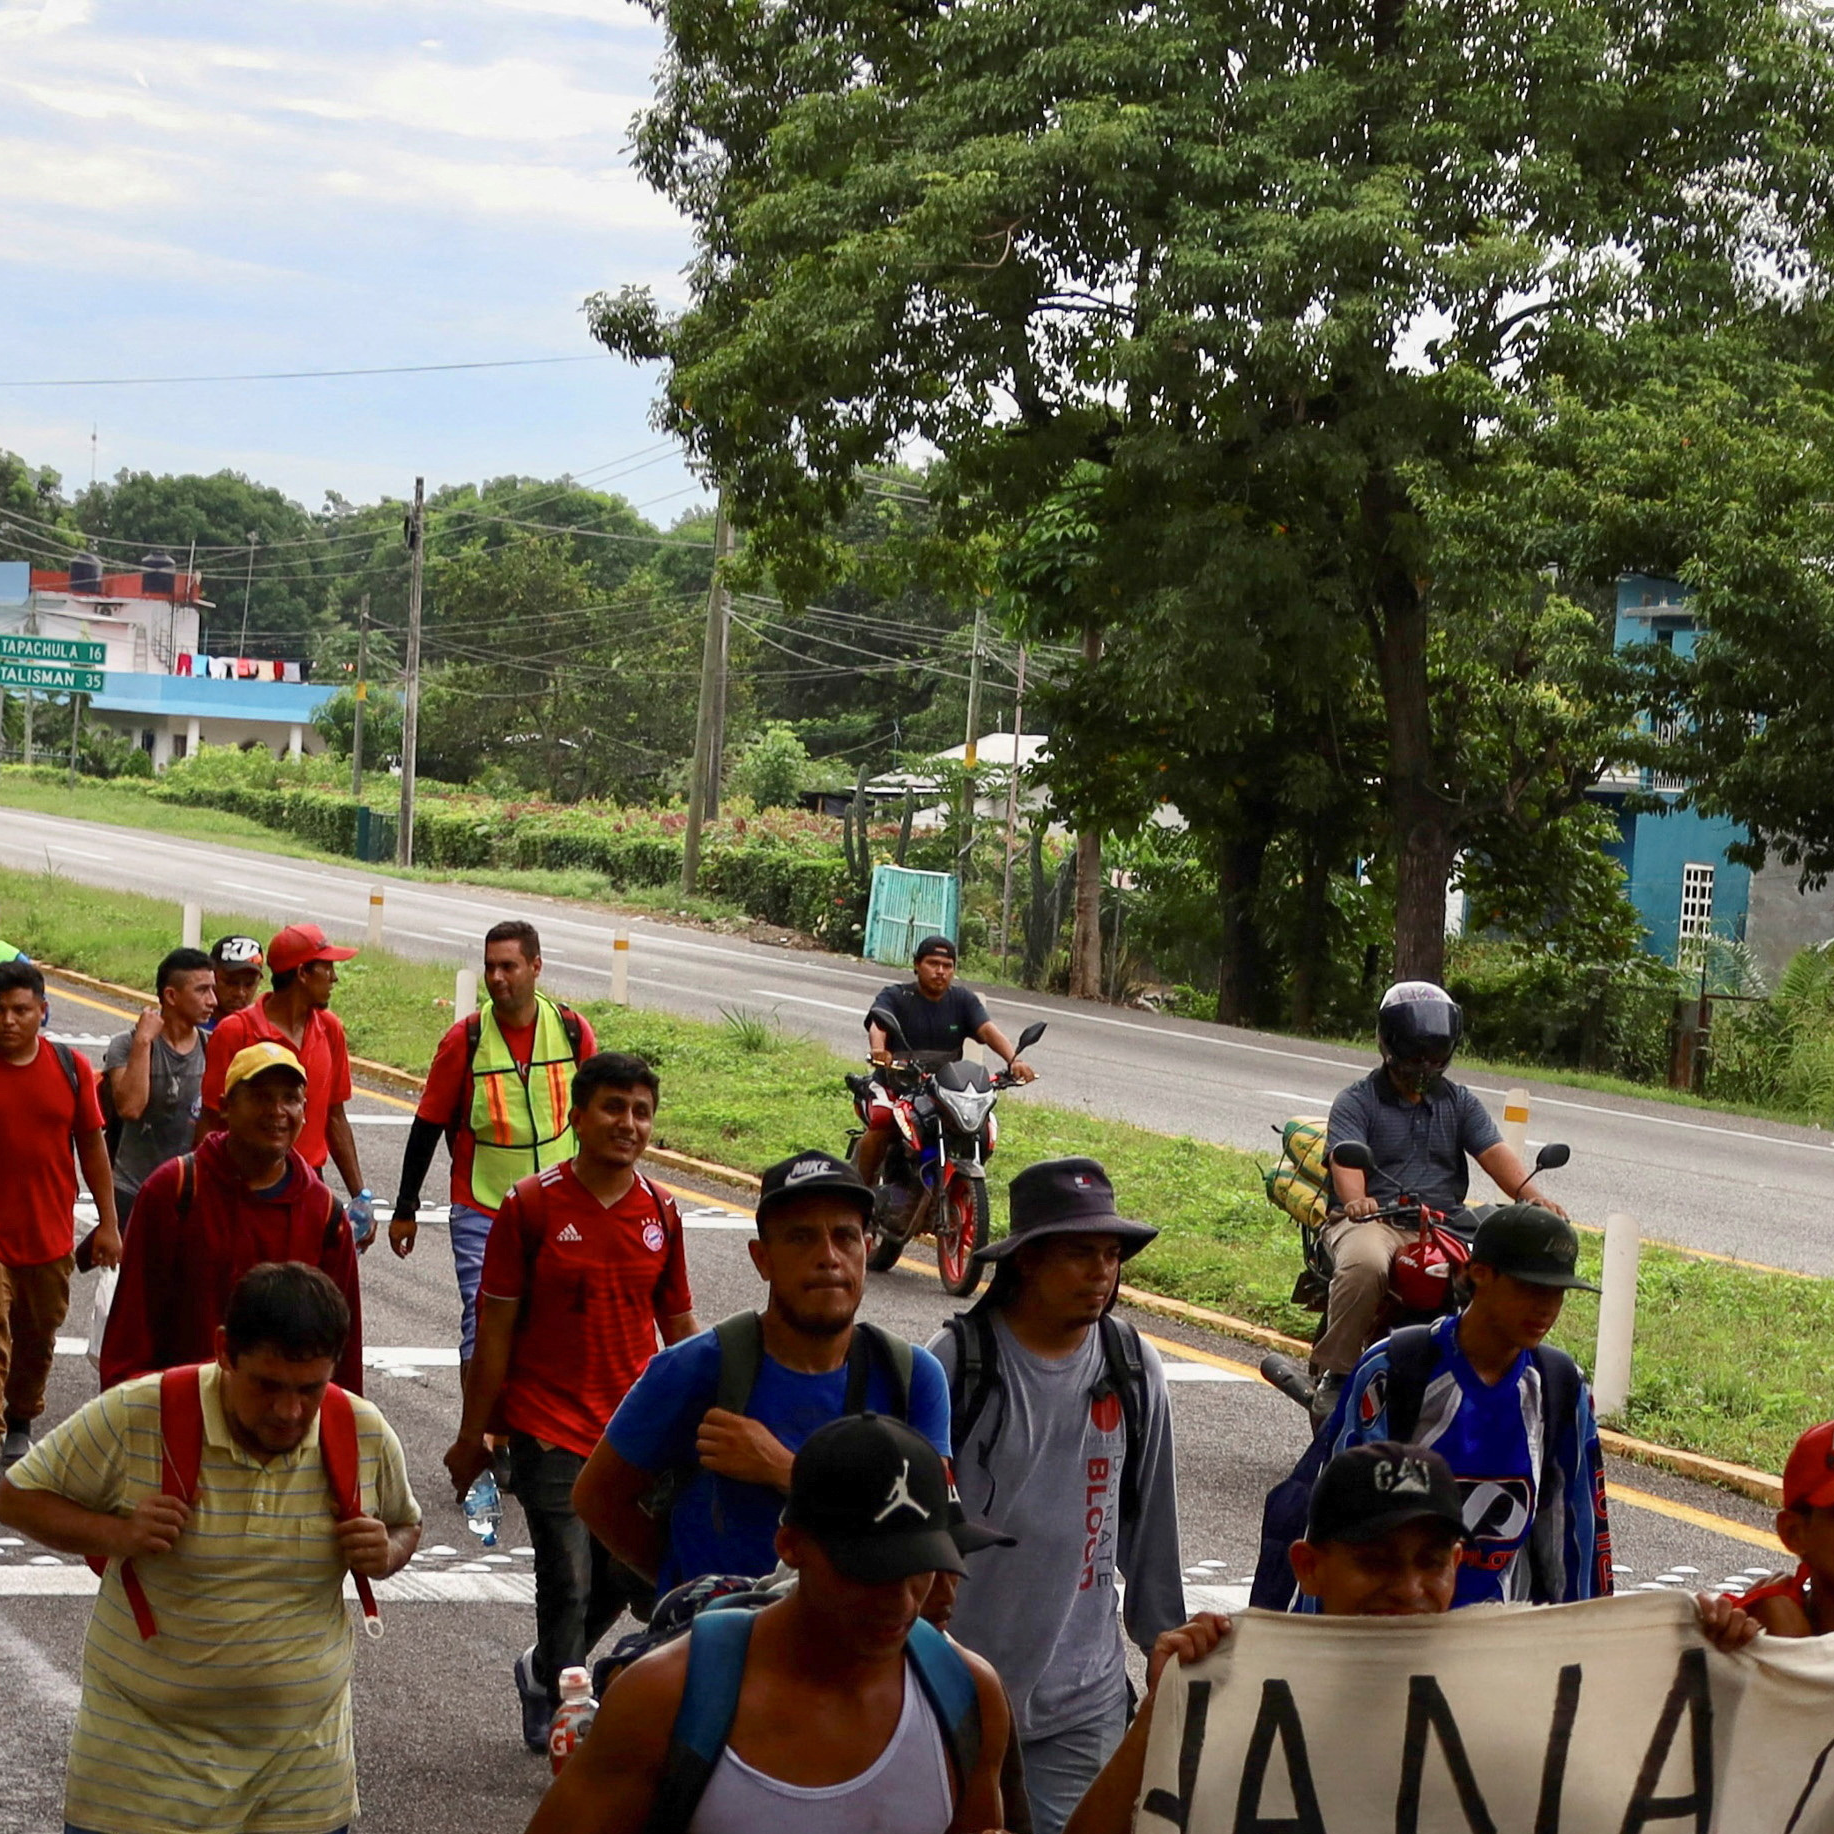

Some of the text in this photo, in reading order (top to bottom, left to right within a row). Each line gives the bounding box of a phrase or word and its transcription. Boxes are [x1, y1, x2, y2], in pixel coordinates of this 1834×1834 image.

[1, 639, 102, 660] TAPACHULA 16
[0, 666, 102, 688] TALISMAN 35
[792, 1160, 832, 1176] NIKE
[1097, 1454, 1124, 1589] DONATE
